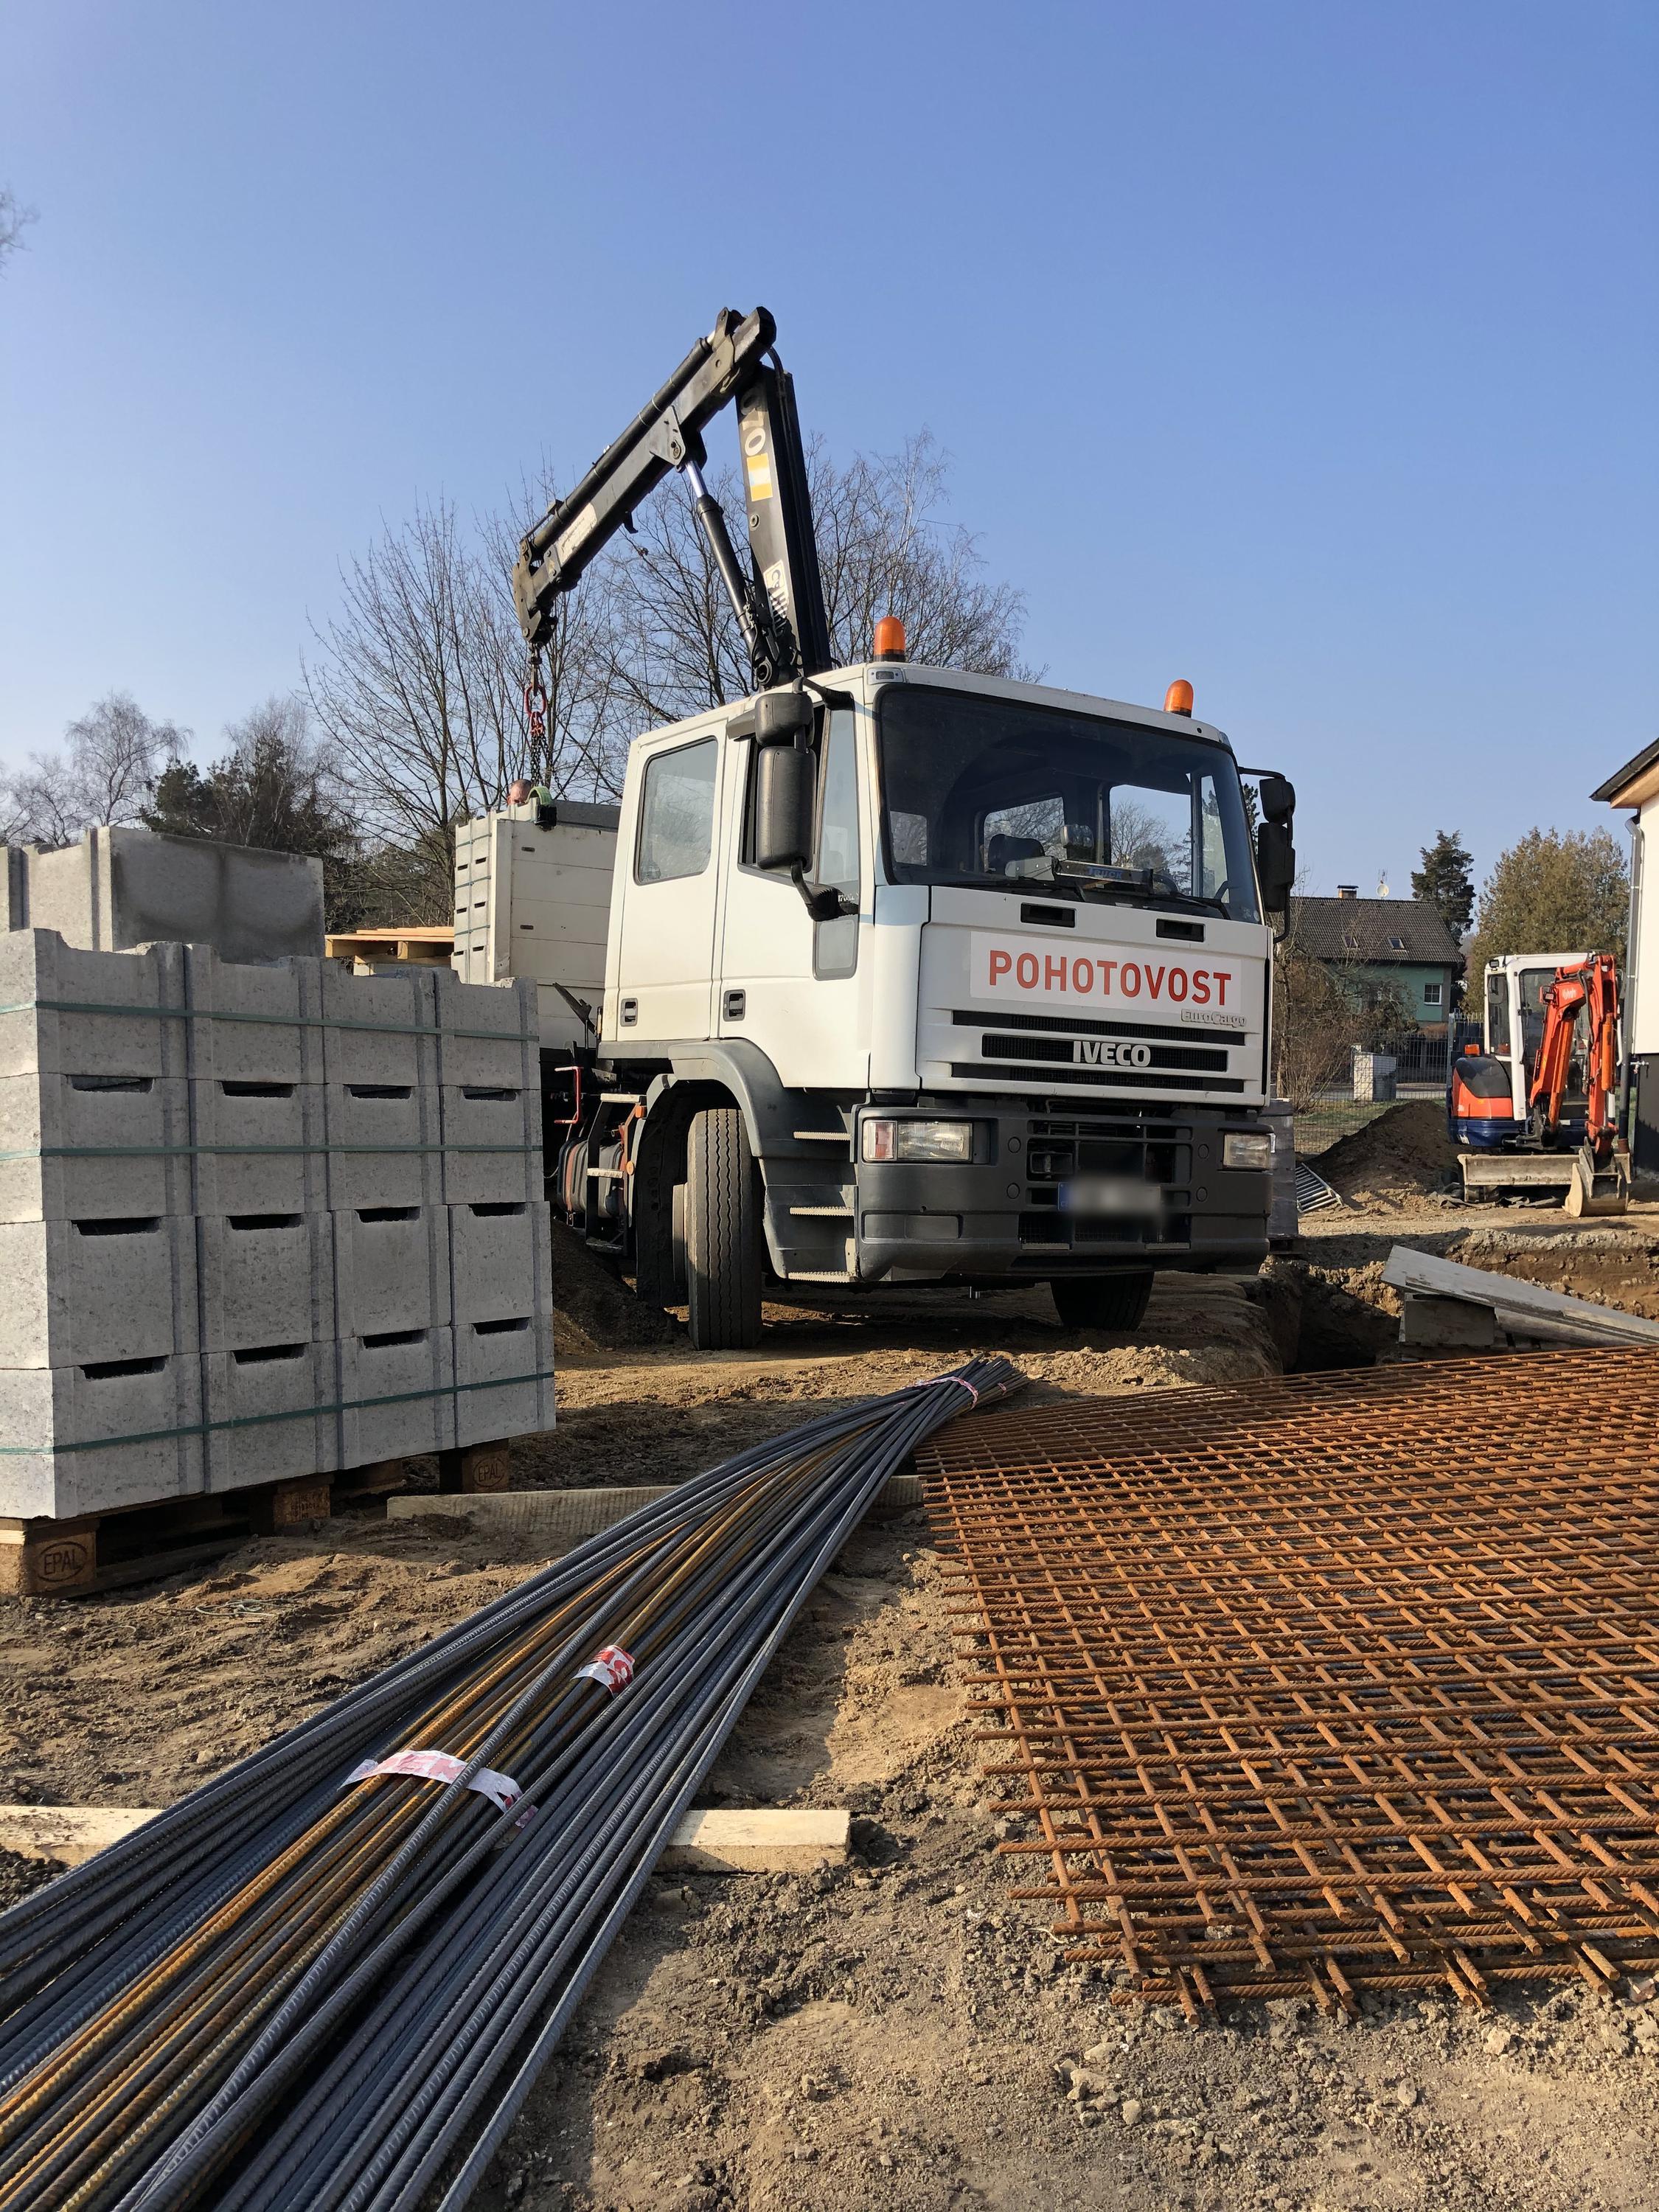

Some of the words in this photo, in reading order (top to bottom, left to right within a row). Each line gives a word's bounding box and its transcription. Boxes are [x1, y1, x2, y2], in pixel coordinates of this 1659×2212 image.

[989, 950, 1232, 1006] POHOTOVOST
[1181, 1009, 1247, 1028] EuroCargo
[1073, 1040, 1151, 1068] IVECO
[479, 1463, 501, 1482] EPAL
[44, 1548, 80, 1575] EPAL
